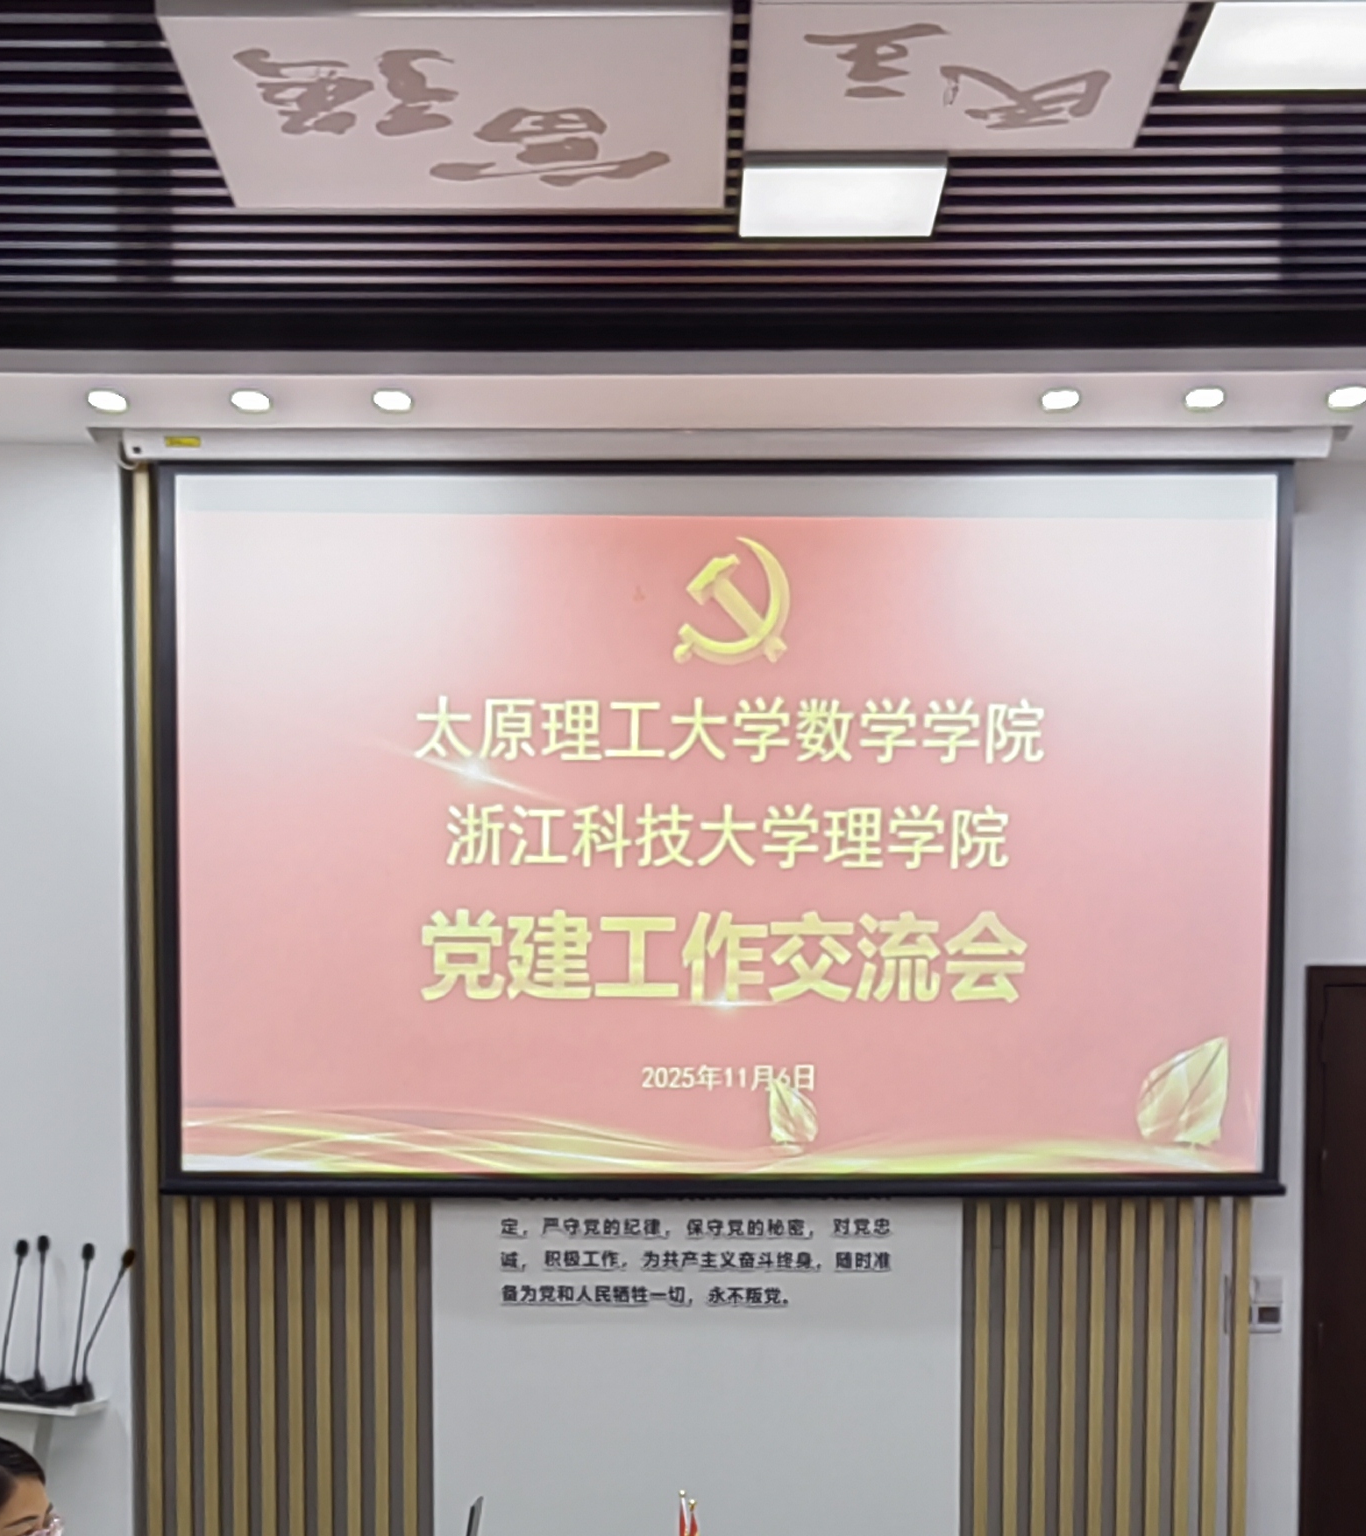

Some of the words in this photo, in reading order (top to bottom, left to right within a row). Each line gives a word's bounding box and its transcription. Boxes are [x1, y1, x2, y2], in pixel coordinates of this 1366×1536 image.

[414, 694, 1046, 764] 太原理工大学数学学院
[445, 802, 1011, 870] 浙江科技大学理学院
[419, 909, 1029, 1003] 党建工作交流会
[641, 1064, 815, 1092] 2025年11月6日
